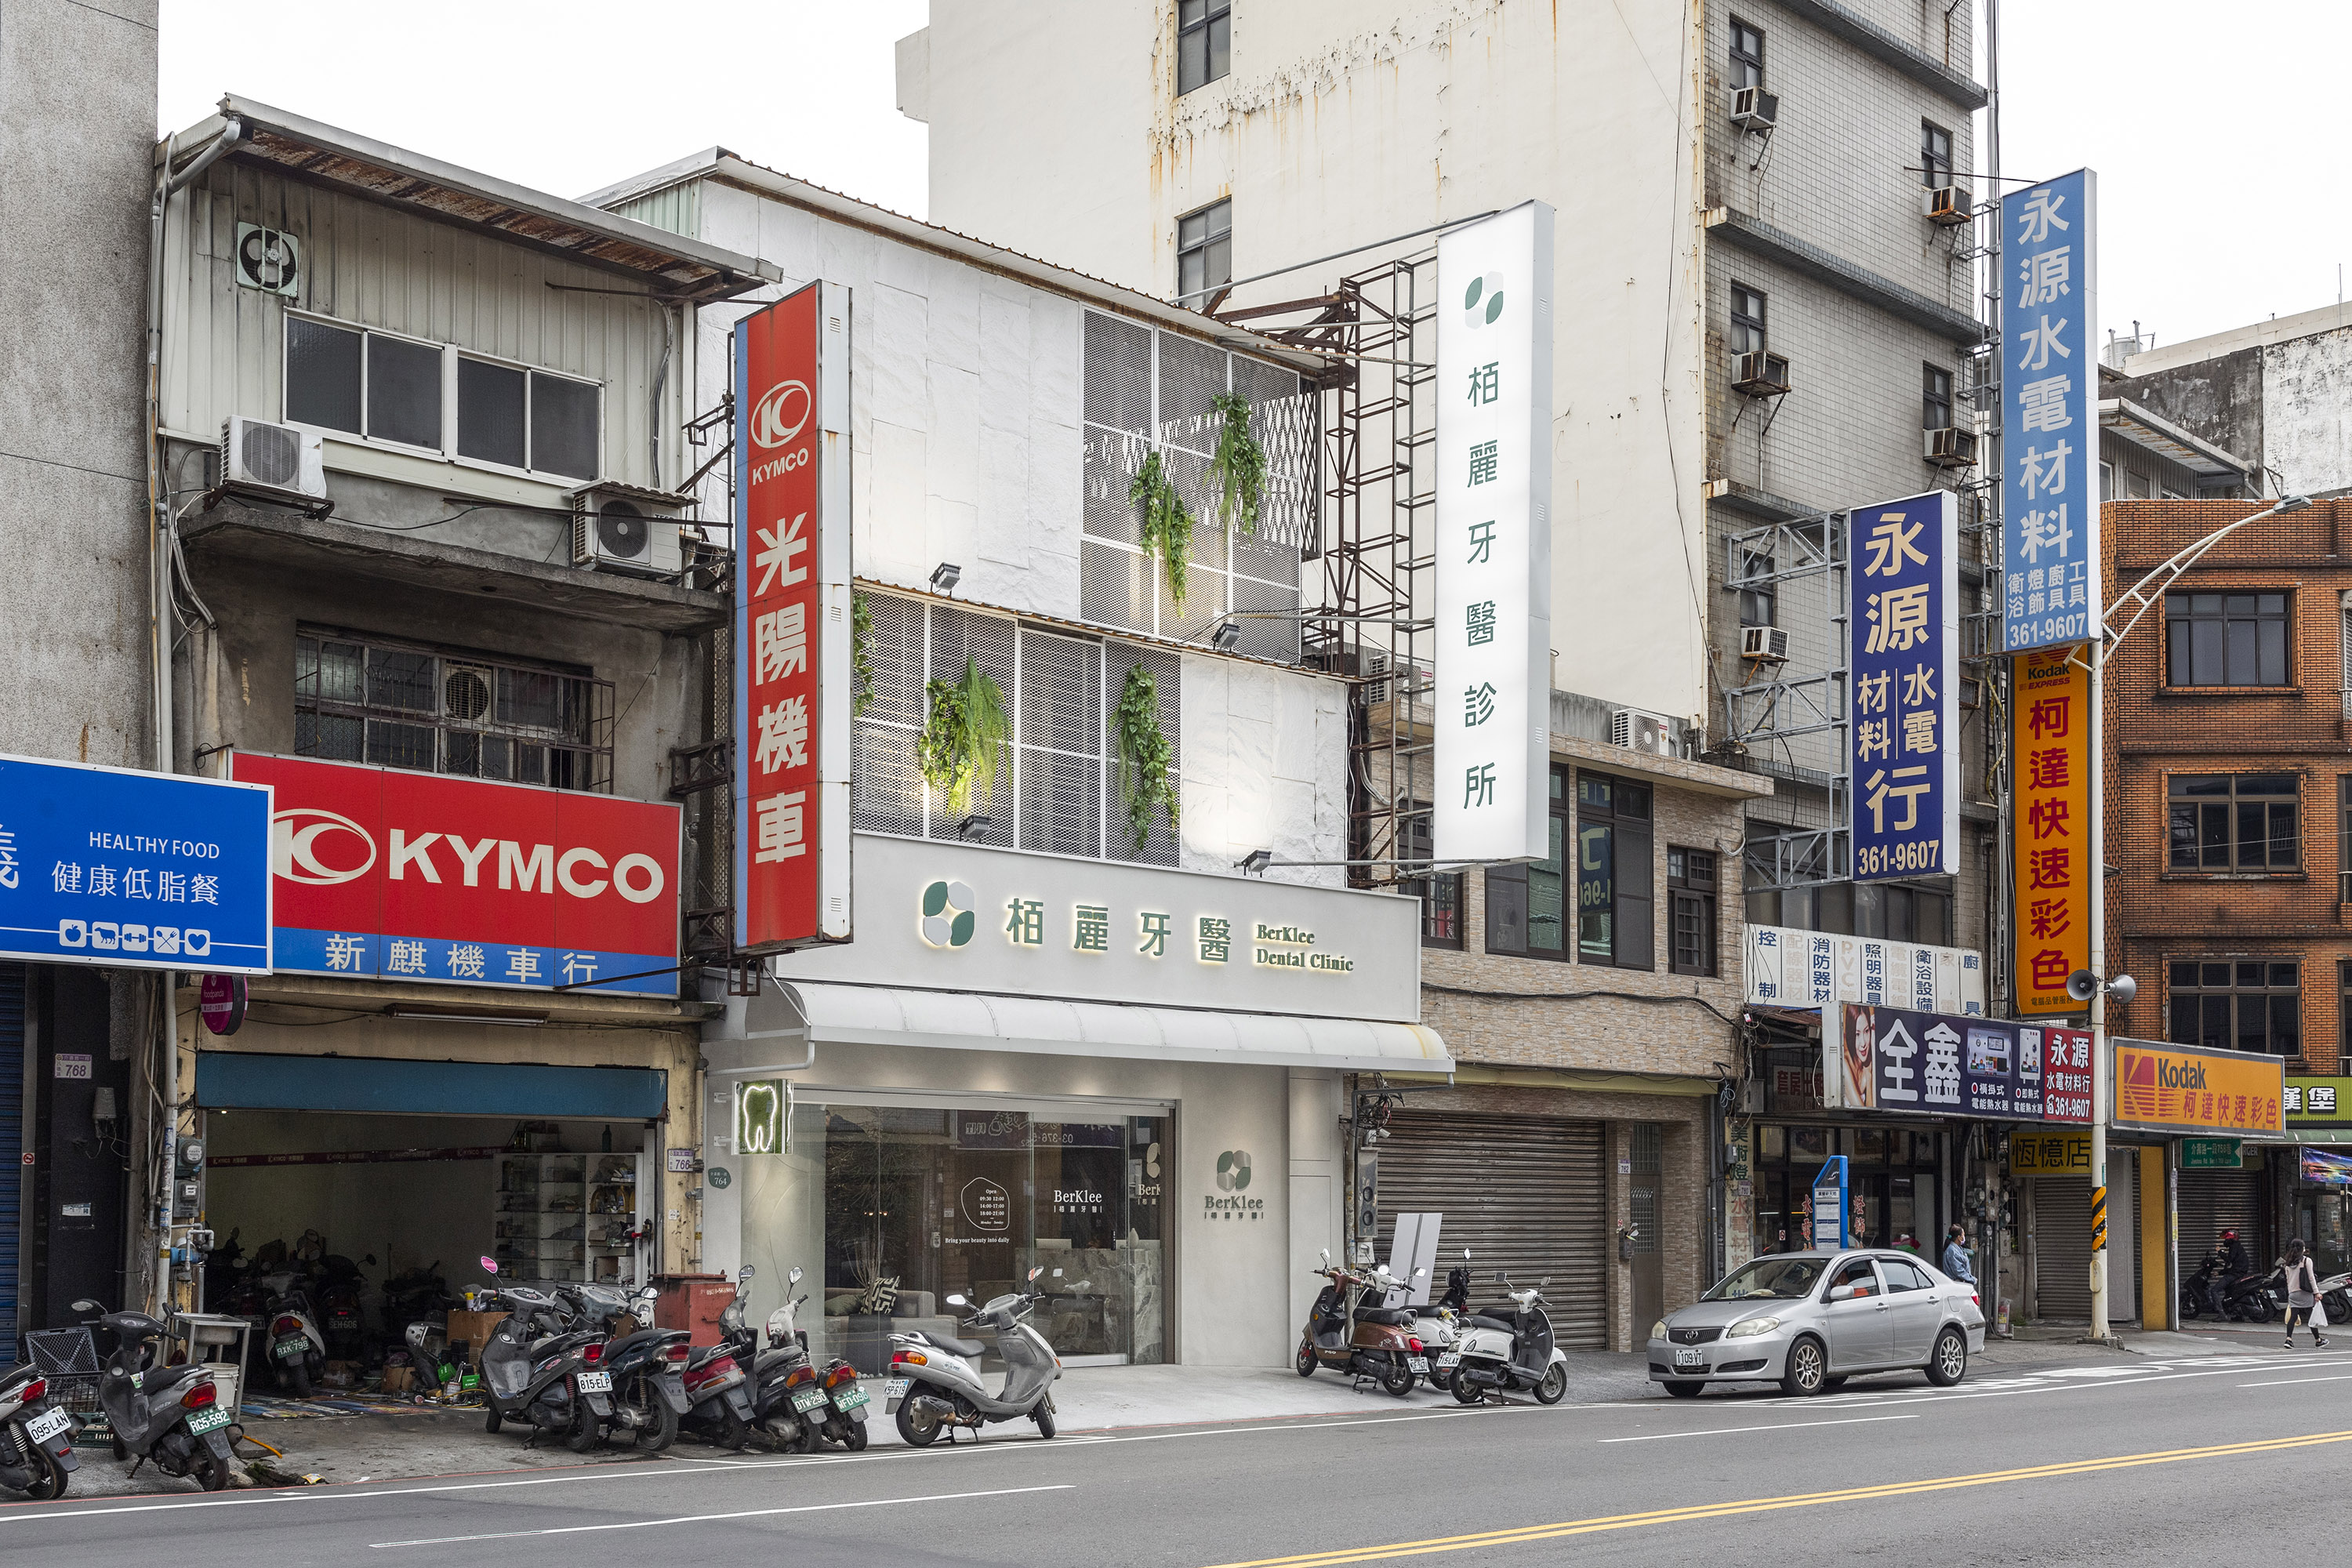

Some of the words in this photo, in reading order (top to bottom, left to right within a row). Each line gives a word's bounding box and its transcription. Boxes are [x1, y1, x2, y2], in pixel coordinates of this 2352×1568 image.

[2018, 188, 2073, 564] 永源水電材料
[753, 448, 808, 486] KYMCO
[1463, 361, 1500, 810] 栢麗牙醫診所
[1864, 513, 1929, 654] 永源
[2009, 612, 2086, 647] 361-9607
[754, 511, 808, 863] 光陽機車
[2027, 664, 2070, 680] Kodak
[2028, 677, 2070, 690] EXPRESS
[1857, 670, 1891, 762] 材料
[1903, 662, 1937, 754] 水電
[1865, 764, 1930, 833] 行
[89, 831, 169, 854] HEALTHY
[172, 840, 220, 859] FOOD
[1858, 840, 1940, 875] 361-9607
[2028, 695, 2071, 990] 柯達快速彩色
[390, 828, 665, 904] KYMCO
[52, 860, 220, 906] 健康低脂餐
[1006, 898, 1231, 962] 栢麗牙醫
[1256, 924, 1316, 945] BerKlee
[325, 933, 598, 985] 新麒機車行
[1256, 949, 1305, 967] Dental
[1310, 954, 1354, 972] Clinic
[1813, 936, 1831, 1003] 消防器材
[204, 989, 224, 1000] foodpanda
[1879, 1018, 1961, 1104] 全鑫
[2050, 1034, 2089, 1069] 永源
[66, 1065, 86, 1076] 768
[2046, 1072, 2091, 1094] 水電材料行
[2158, 1058, 2207, 1090] Kodak
[1971, 1098, 2009, 1111] 電能熱水器
[2014, 1102, 2043, 1114] 電能熱水器
[2055, 1097, 2091, 1117] 361-9607
[2183, 1090, 2277, 1124] 柯達快速彩色
[675, 1160, 691, 1170] 766
[1054, 1190, 1102, 1203] BerKlee
[1204, 1196, 1263, 1208] BerKlee
[277, 1340, 308, 1356] RXK-798
[580, 1378, 610, 1390] 815-ELP
[31, 1413, 69, 1440] 095-LAN
[190, 1410, 230, 1432] RG5-592
